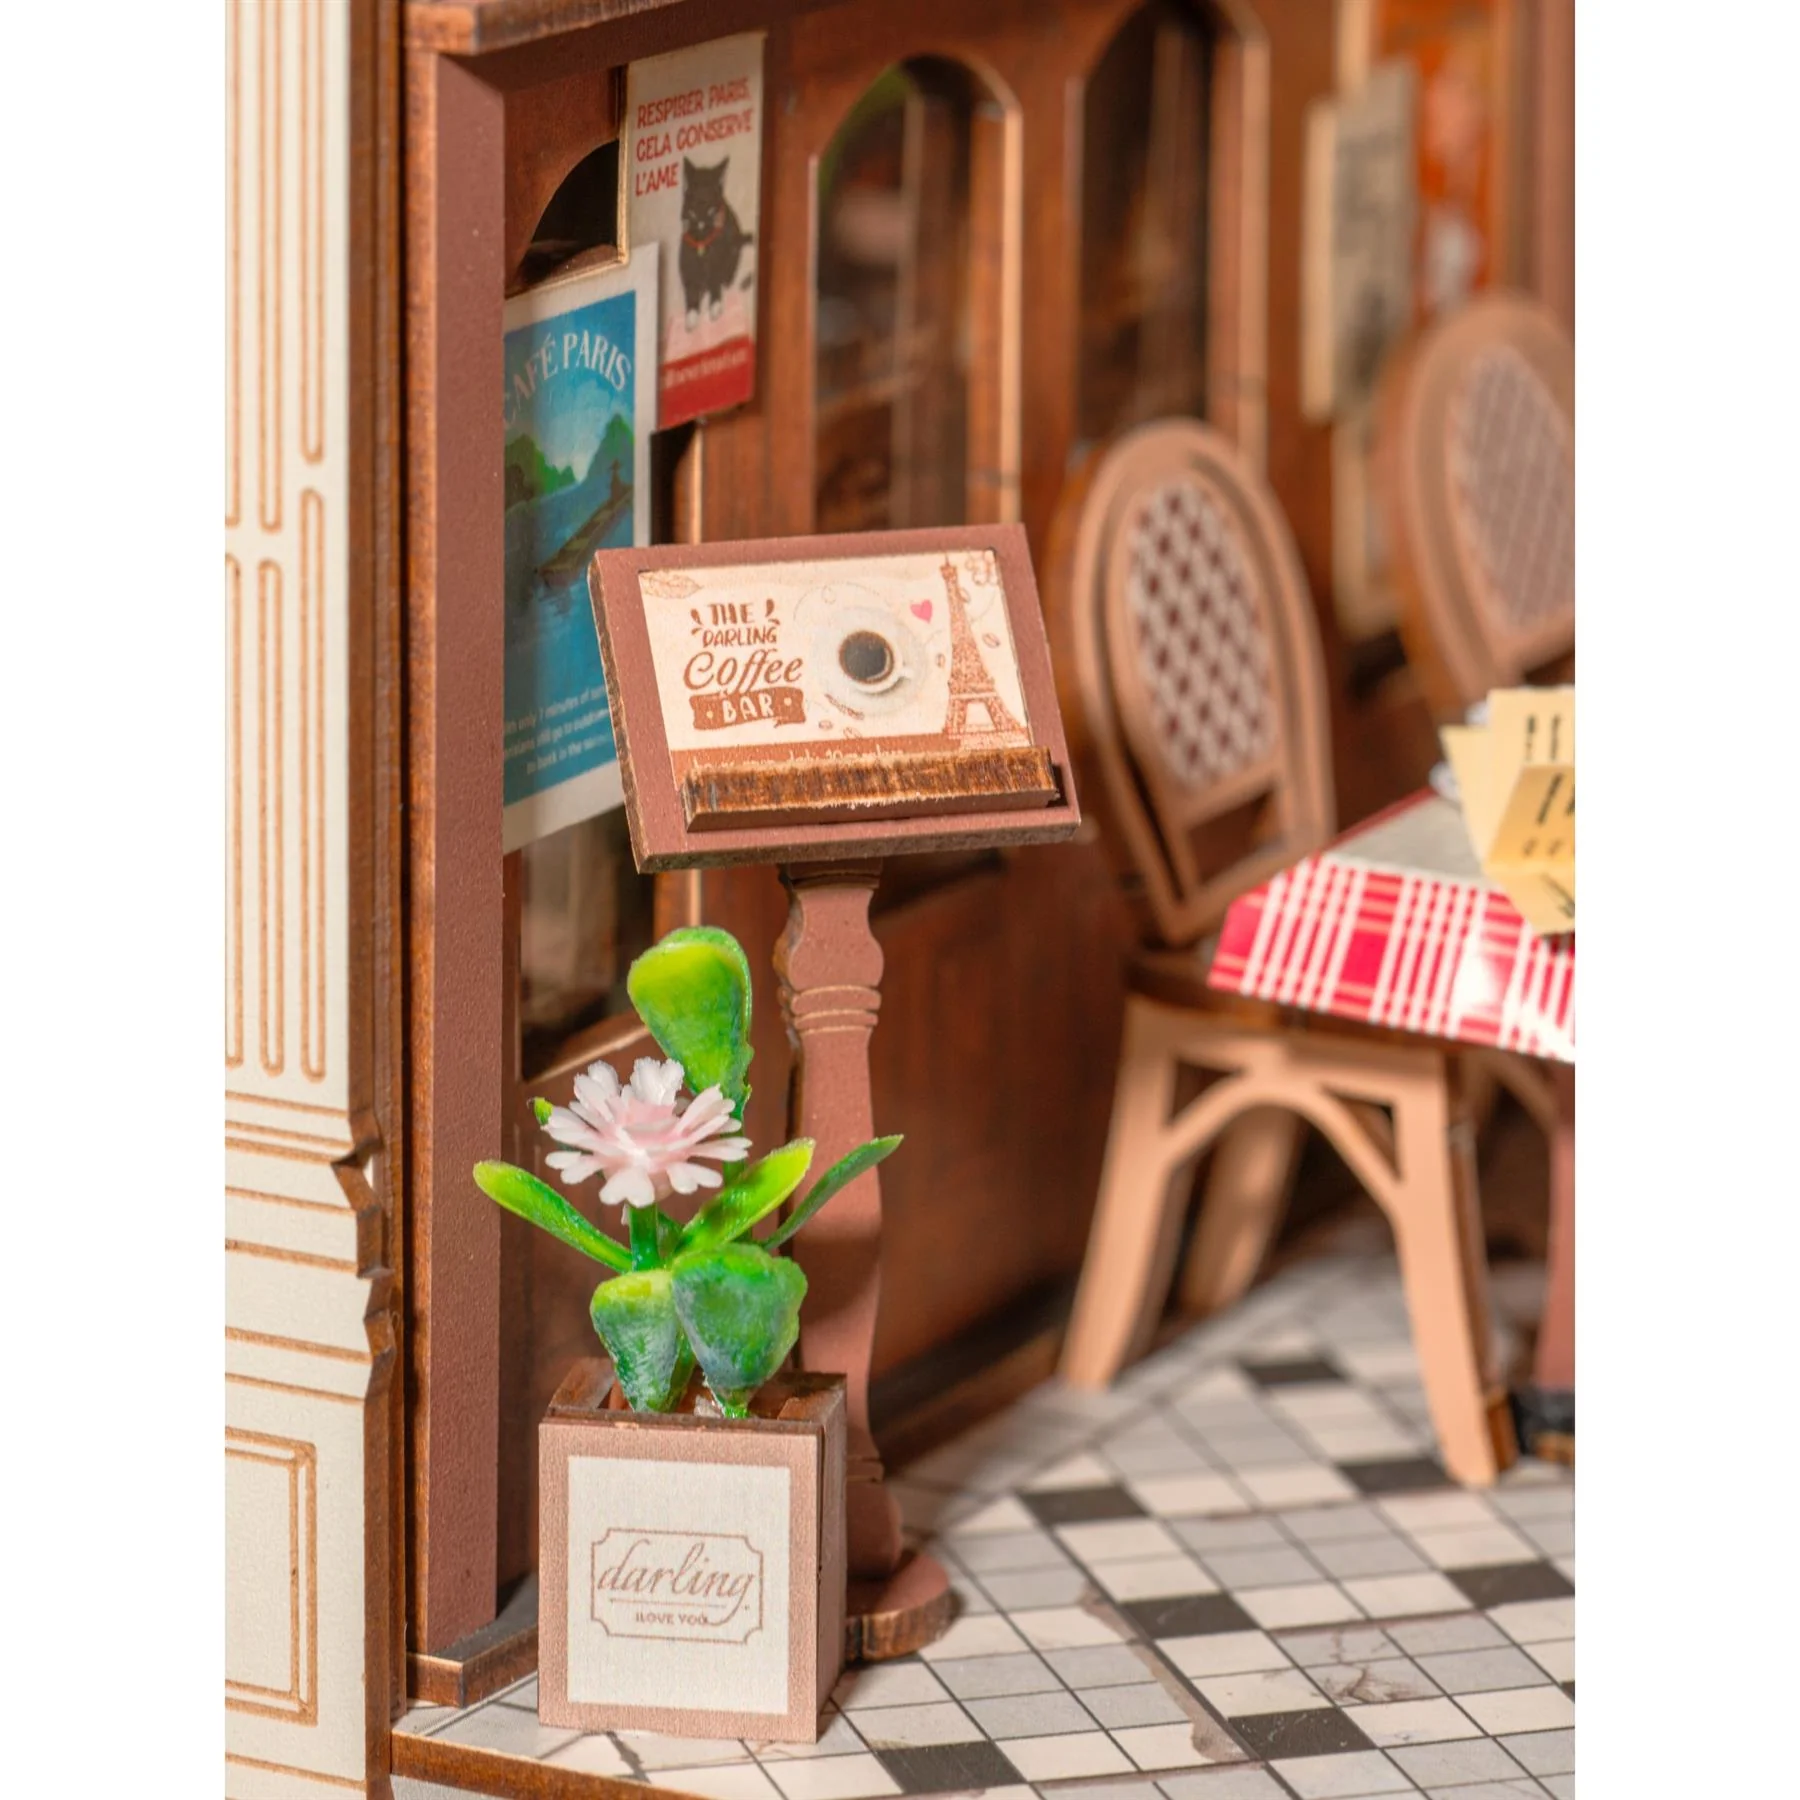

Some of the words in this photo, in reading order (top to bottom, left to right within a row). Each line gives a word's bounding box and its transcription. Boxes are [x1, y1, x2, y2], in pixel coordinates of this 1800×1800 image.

[637, 88, 704, 129] RESPIRER
[635, 162, 679, 197] L'AME
[563, 329, 632, 392] PARIS
[707, 602, 755, 626] THE
[702, 625, 778, 648] DARLING
[683, 648, 803, 695] Coffee
[721, 692, 774, 724] BAR
[597, 1538, 756, 1626] darling
